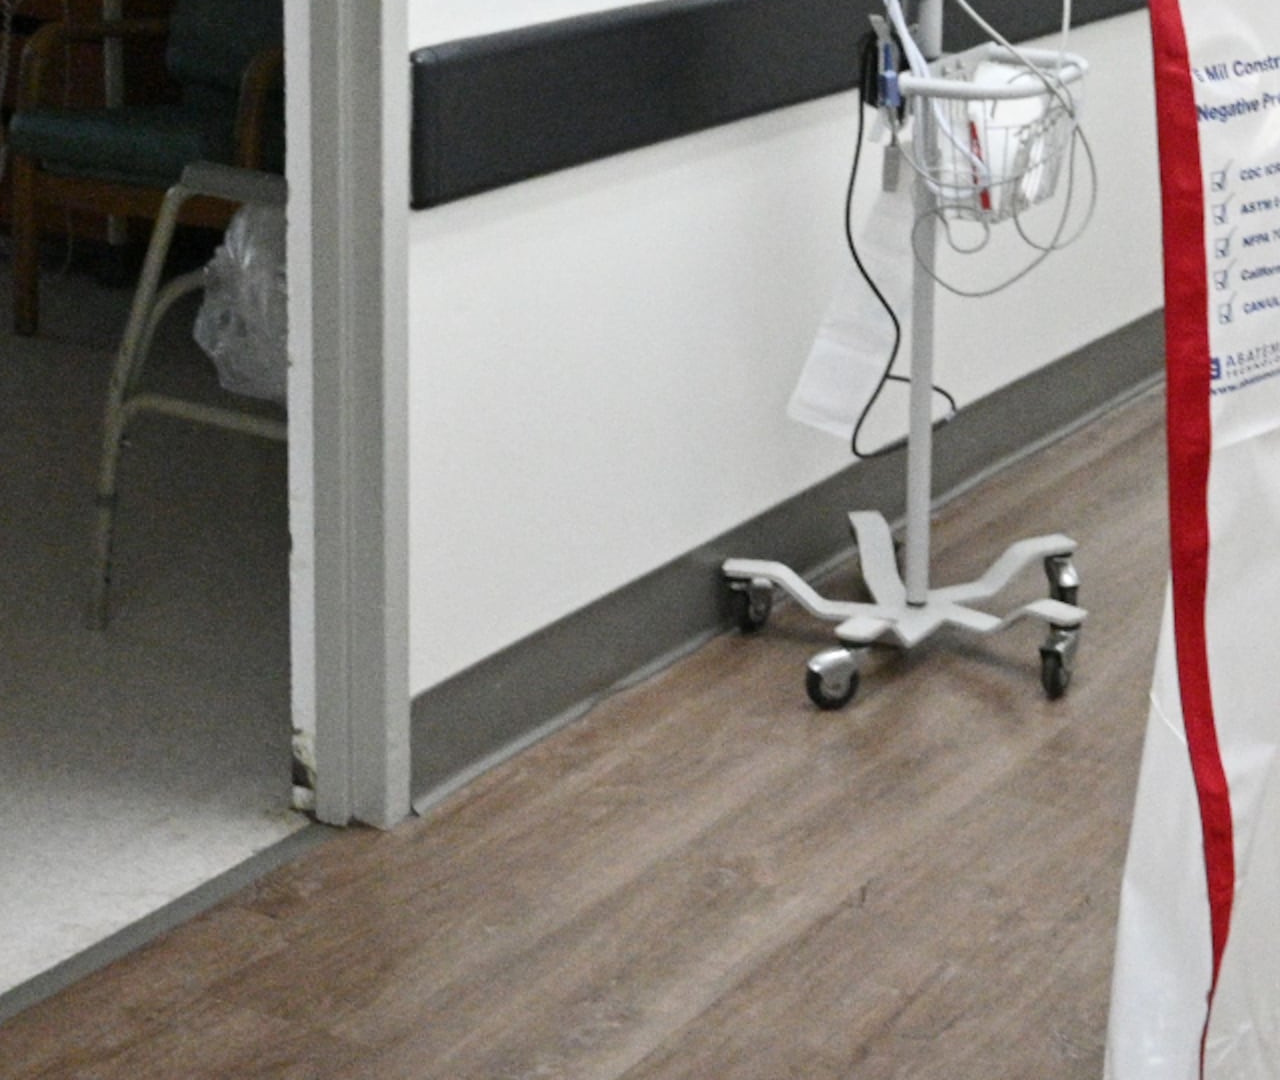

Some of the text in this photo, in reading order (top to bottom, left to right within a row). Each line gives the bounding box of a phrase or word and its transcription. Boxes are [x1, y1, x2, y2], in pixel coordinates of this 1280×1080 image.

[1204, 63, 1229, 82] Mil
[1196, 98, 1259, 123] Negative
[1240, 199, 1272, 215] ASTM
